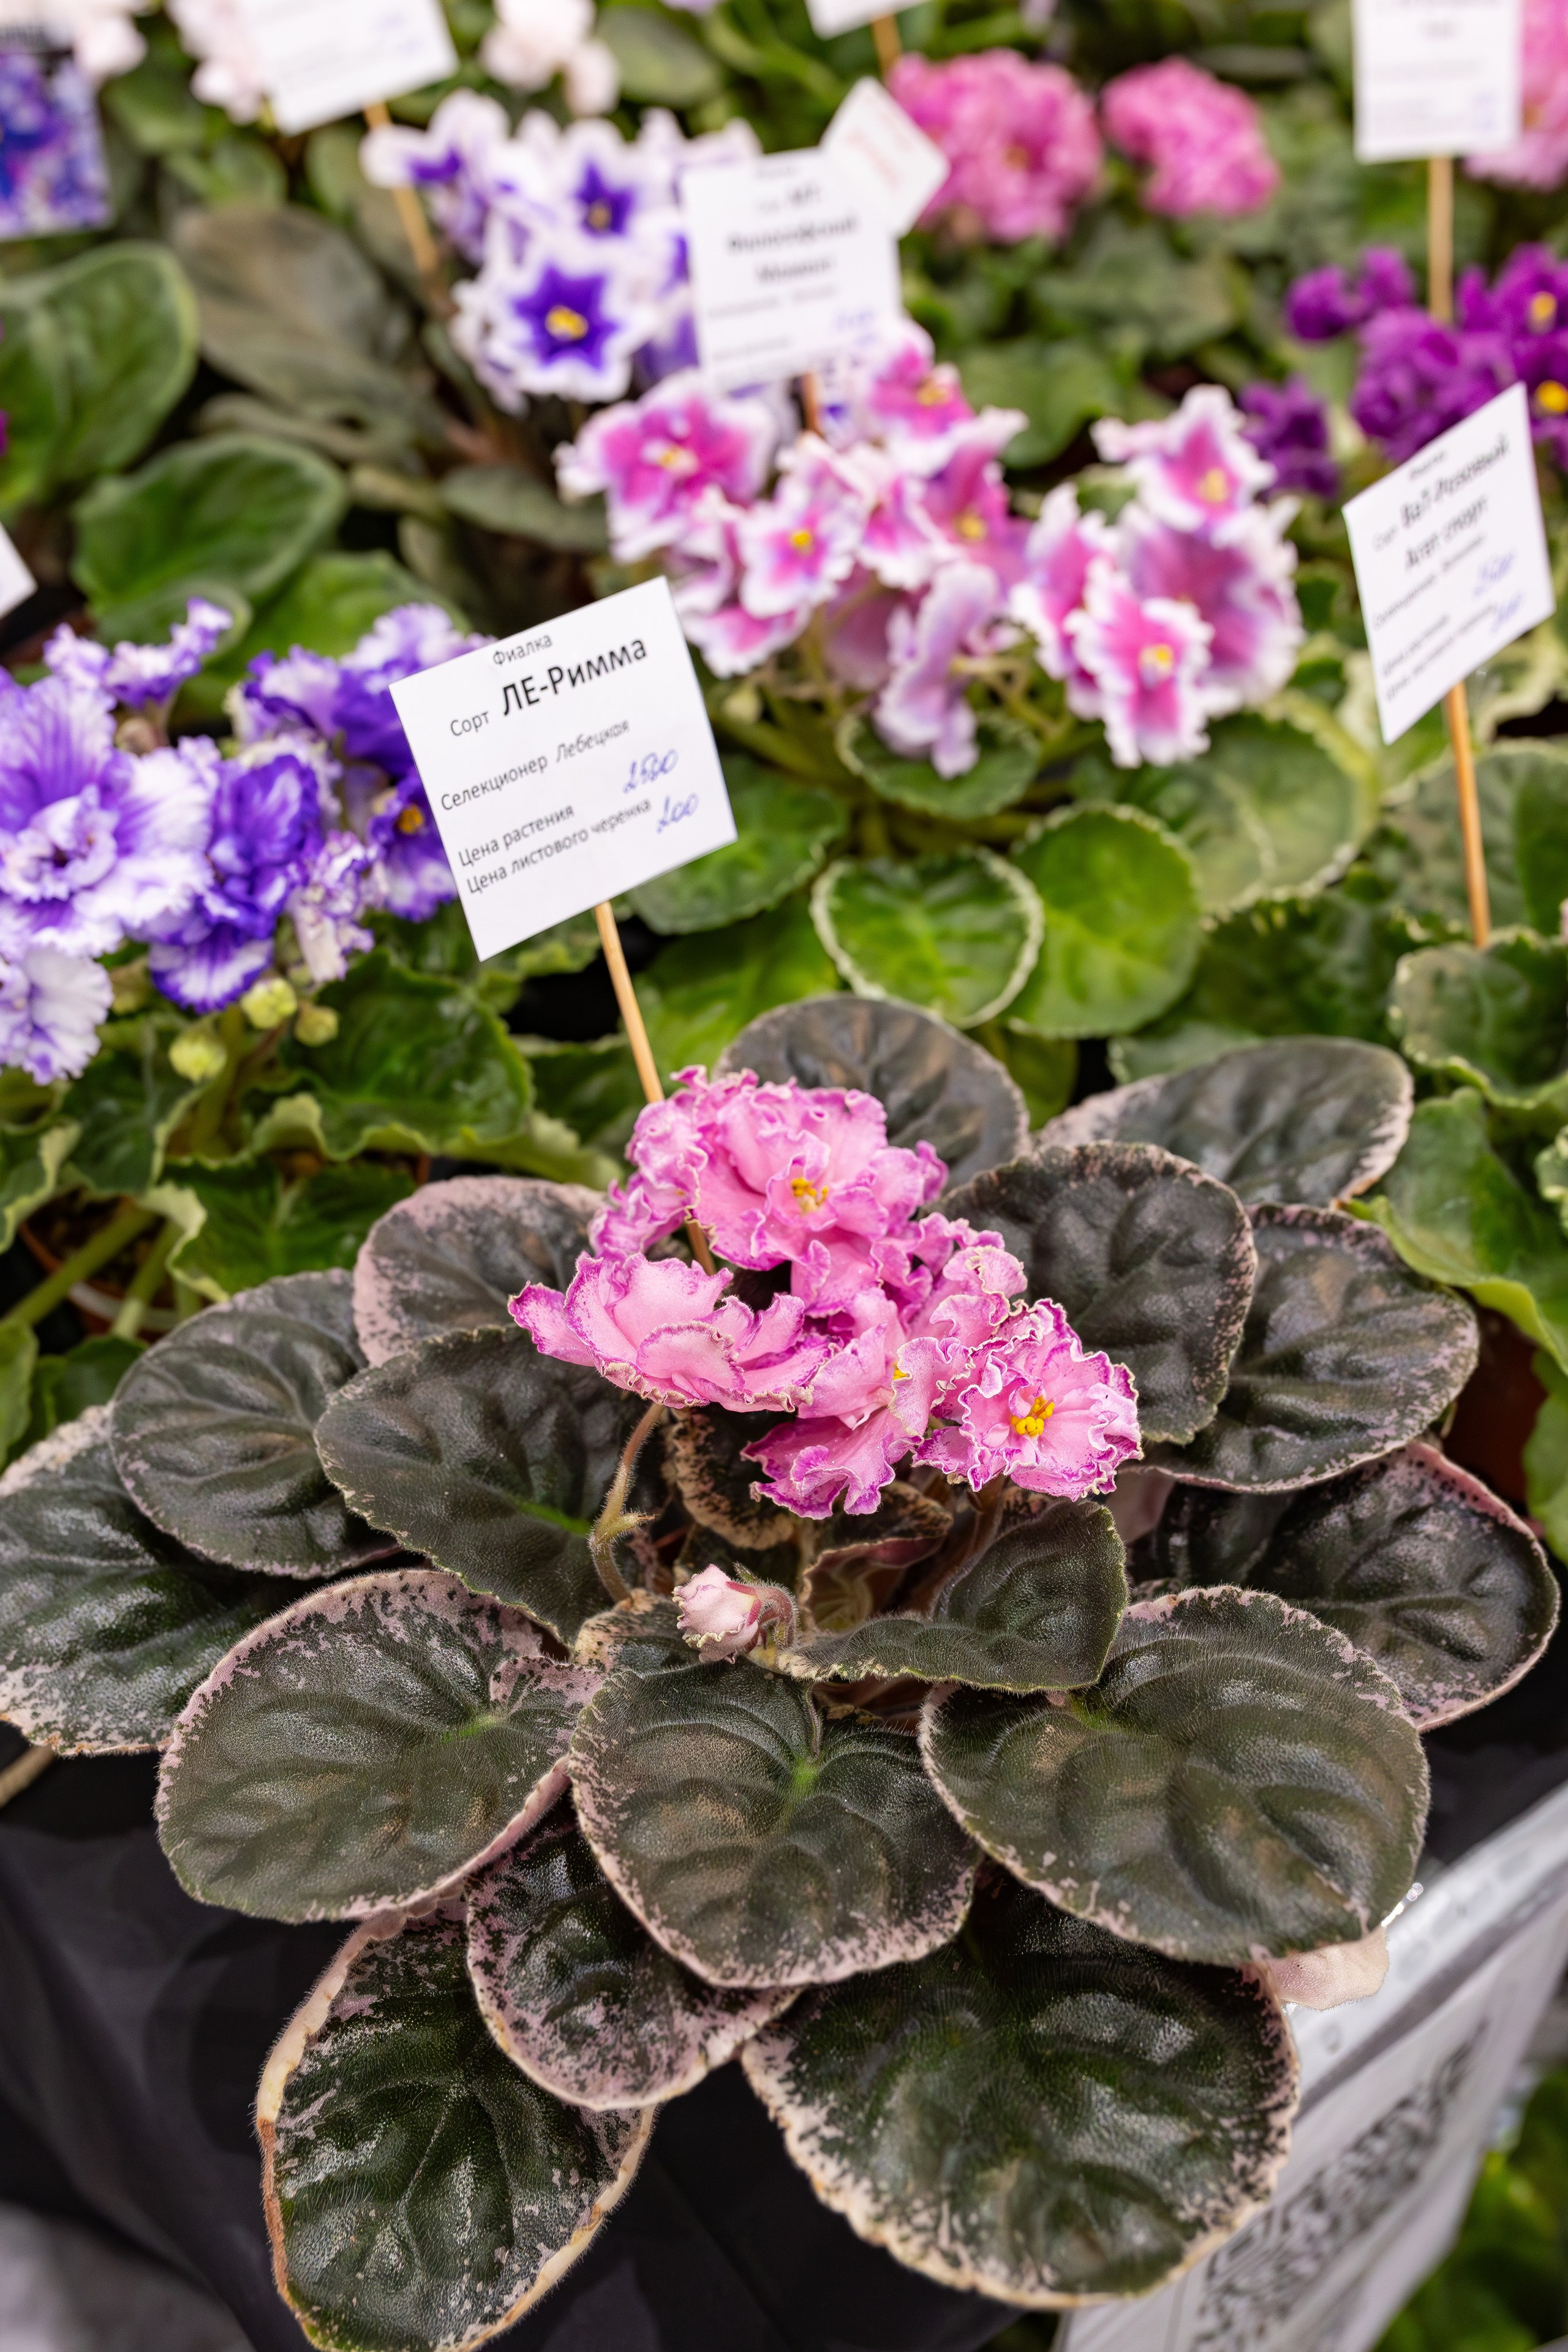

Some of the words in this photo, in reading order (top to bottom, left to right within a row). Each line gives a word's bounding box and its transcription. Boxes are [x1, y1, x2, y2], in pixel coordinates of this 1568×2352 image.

[450, 710, 490, 737] Сорт
[502, 638, 648, 717] ЛЕ-Римма
[492, 635, 553, 666] Фиалка
[441, 756, 548, 812] Селекционер
[556, 720, 629, 763] Лебецкая
[458, 839, 500, 868] Цена
[502, 805, 575, 850] растения
[467, 865, 508, 894] Цена
[511, 828, 589, 875] листового
[590, 798, 652, 834] черенка
